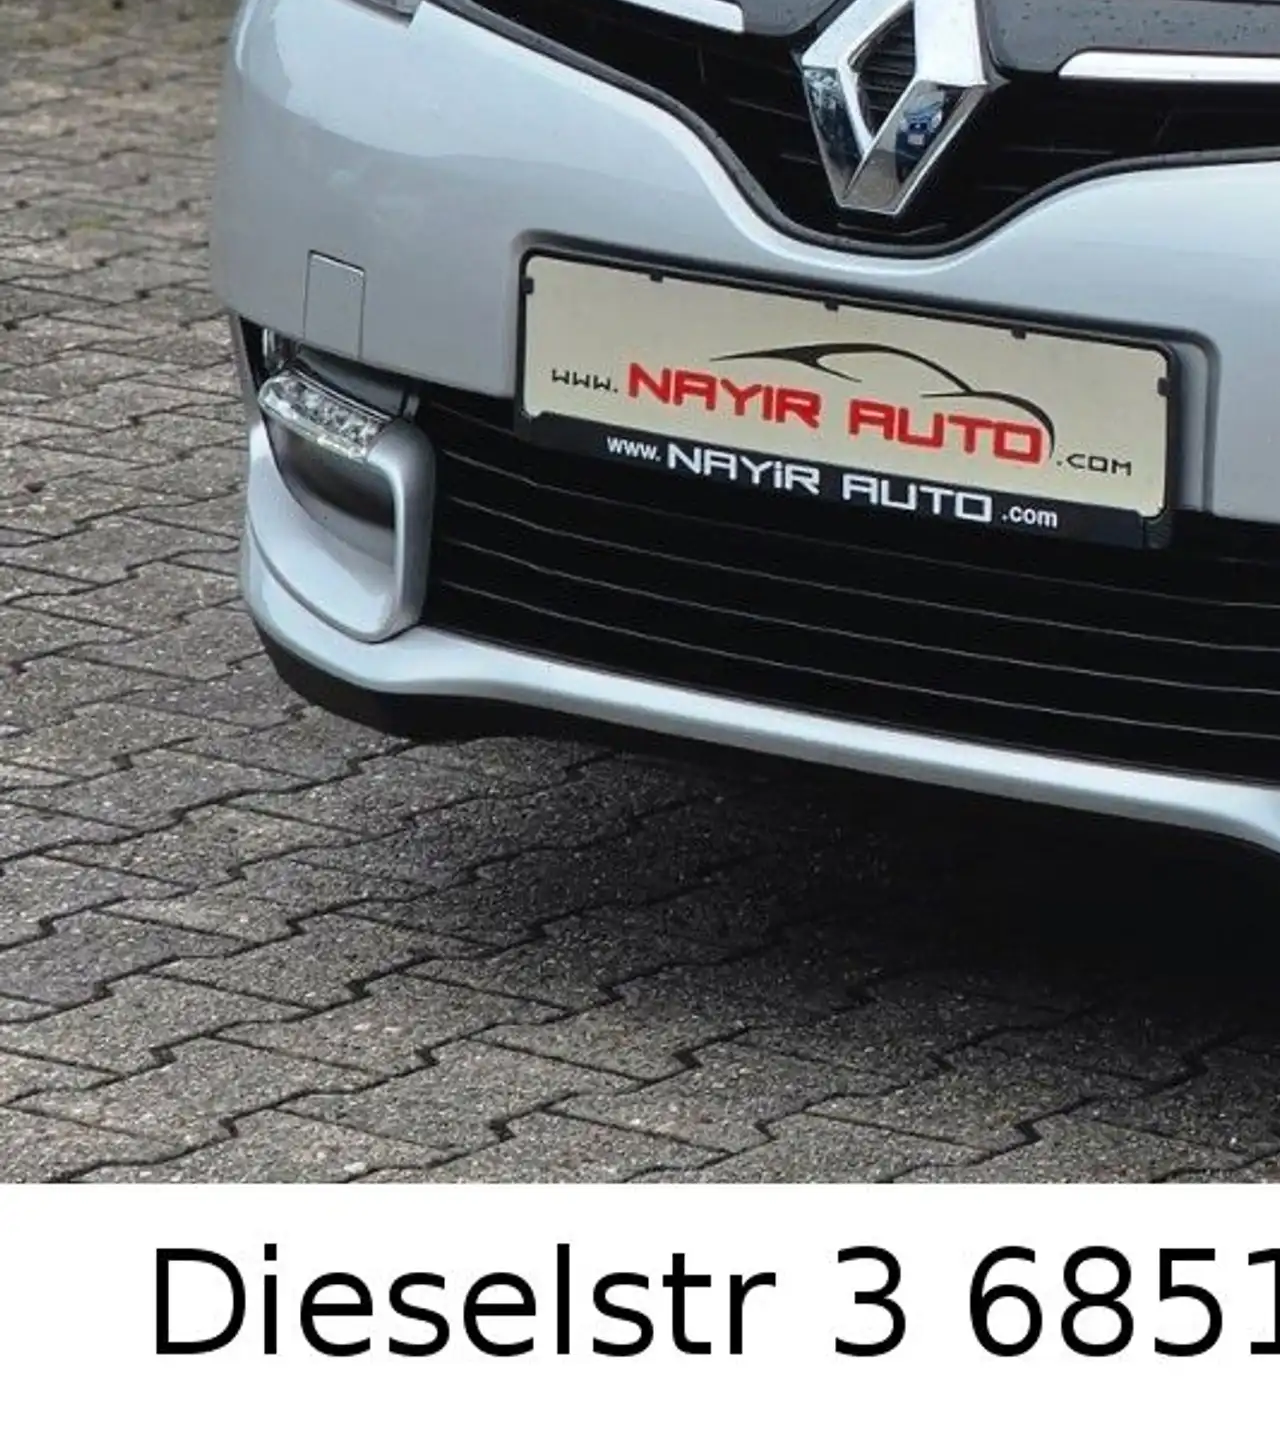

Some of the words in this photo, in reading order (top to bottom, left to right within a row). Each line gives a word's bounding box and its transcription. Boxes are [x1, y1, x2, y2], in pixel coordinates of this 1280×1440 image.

[627, 361, 822, 430] NAYIR
[849, 399, 1043, 465] AUTO
[841, 472, 994, 523] AUTO
